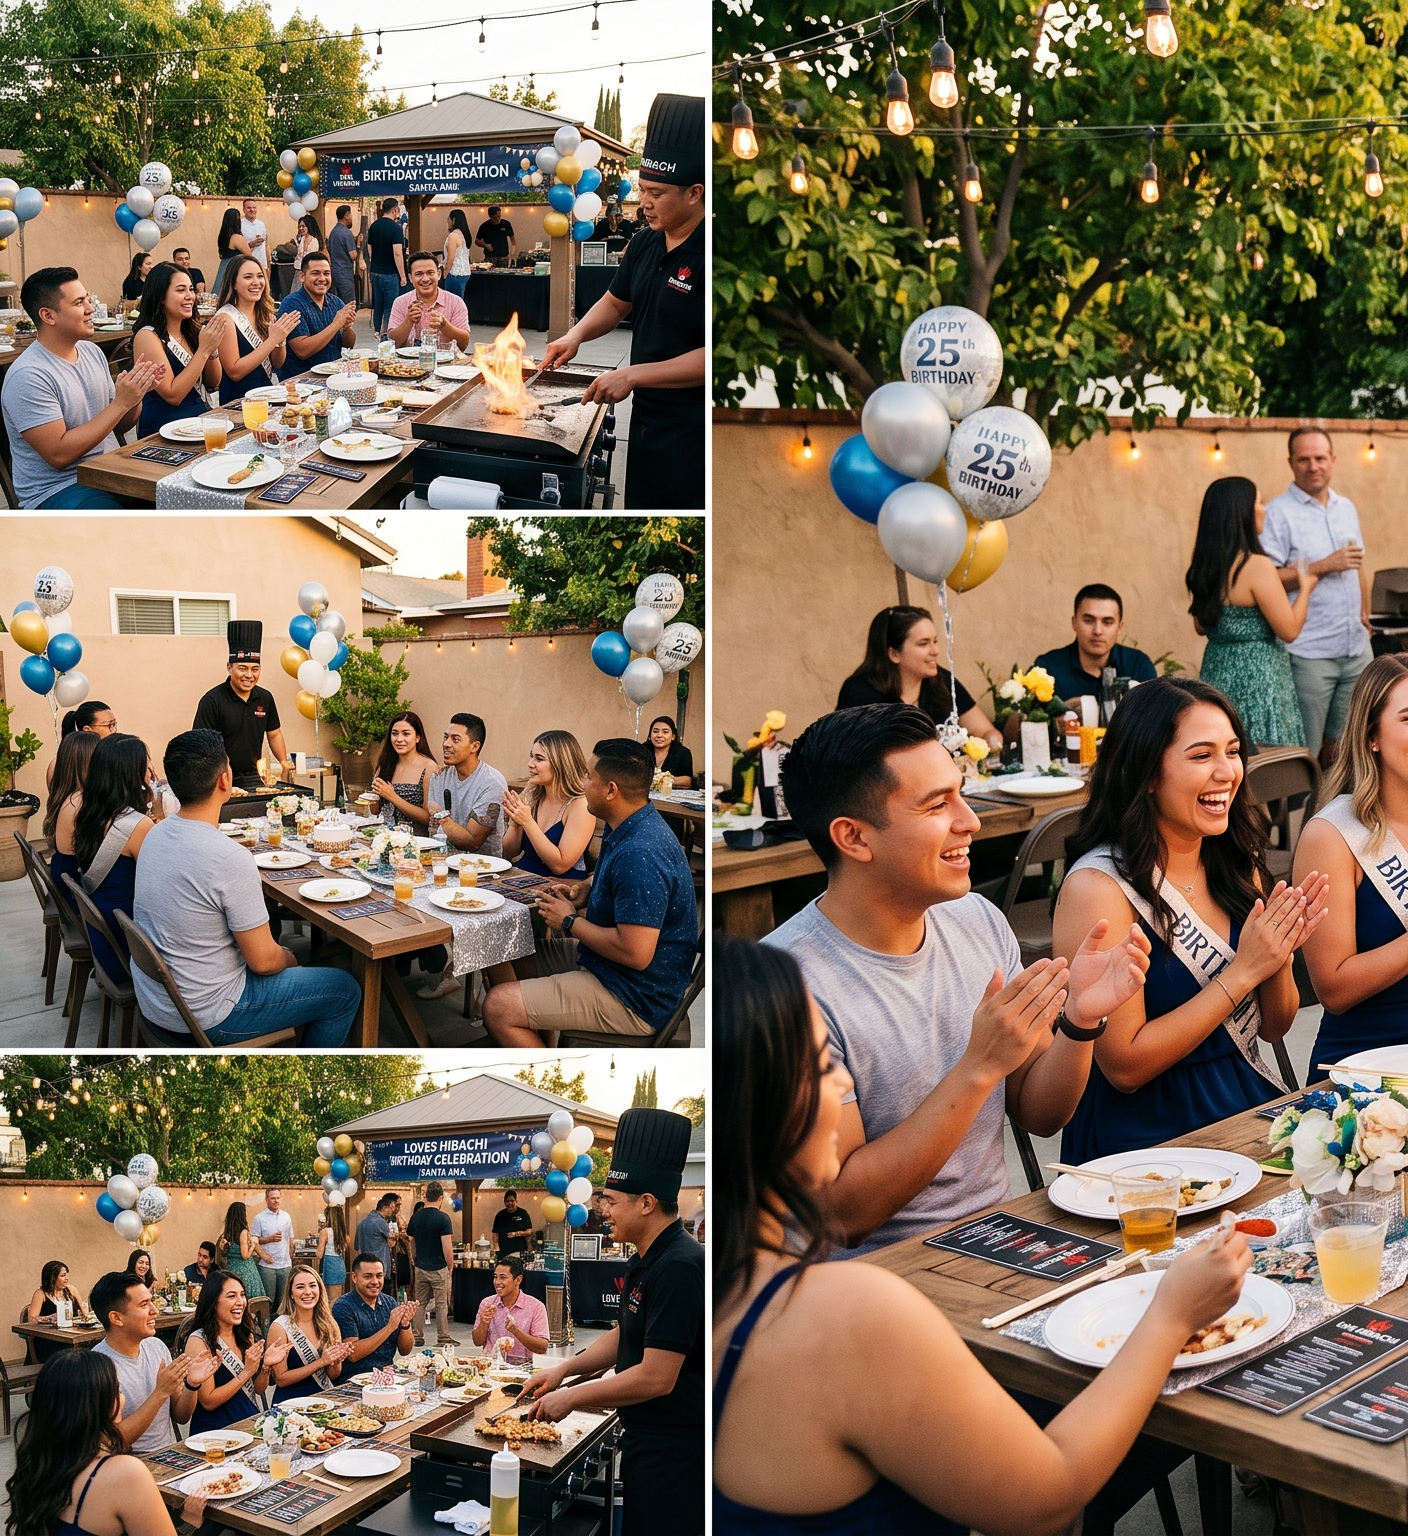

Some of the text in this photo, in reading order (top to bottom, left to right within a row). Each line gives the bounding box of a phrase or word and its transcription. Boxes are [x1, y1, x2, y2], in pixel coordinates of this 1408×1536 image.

[424, 164, 509, 181] CELEBRATION
[917, 321, 968, 335] HAPPY
[911, 370, 976, 385] BIRTHDAY
[958, 470, 1024, 500] BIRTHDAY
[404, 1138, 488, 1154] LOVES HIBACHI
[434, 1151, 510, 1165] CELEBRATION
